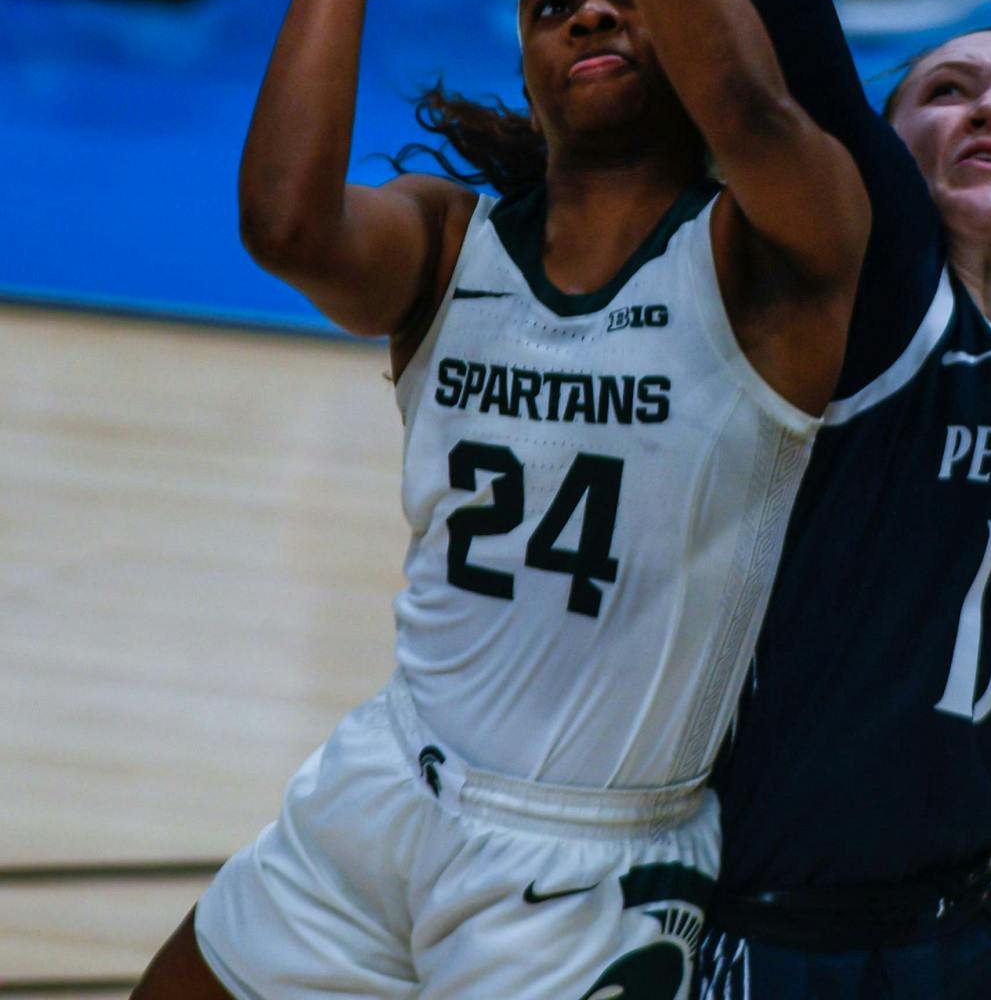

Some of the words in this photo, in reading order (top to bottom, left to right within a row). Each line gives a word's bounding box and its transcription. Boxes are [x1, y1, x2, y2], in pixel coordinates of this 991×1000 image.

[607, 304, 669, 333] BIG
[435, 357, 672, 425] SPARTANS
[446, 439, 625, 618] 24
